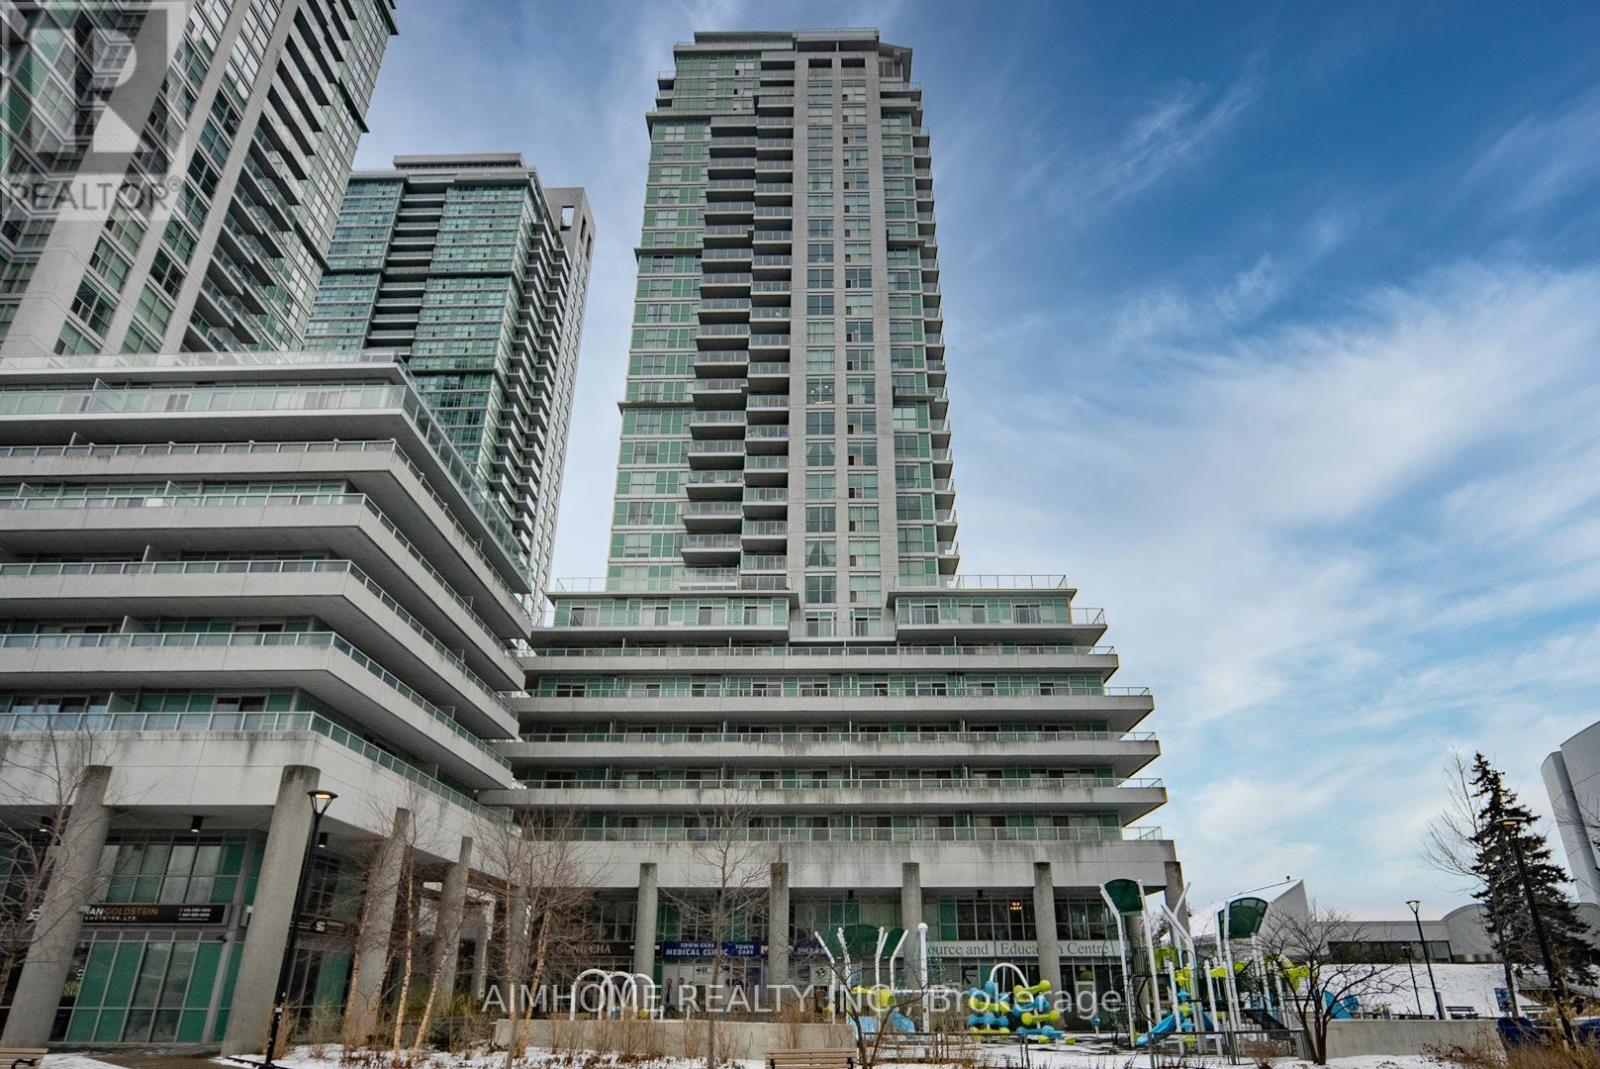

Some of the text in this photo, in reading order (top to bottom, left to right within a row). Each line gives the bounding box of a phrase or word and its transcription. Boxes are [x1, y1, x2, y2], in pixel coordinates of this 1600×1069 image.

[665, 948, 729, 956] MEDICAL CLIIC
[927, 943, 963, 955] ource
[966, 943, 989, 955] and
[1067, 943, 1109, 955] Centre
